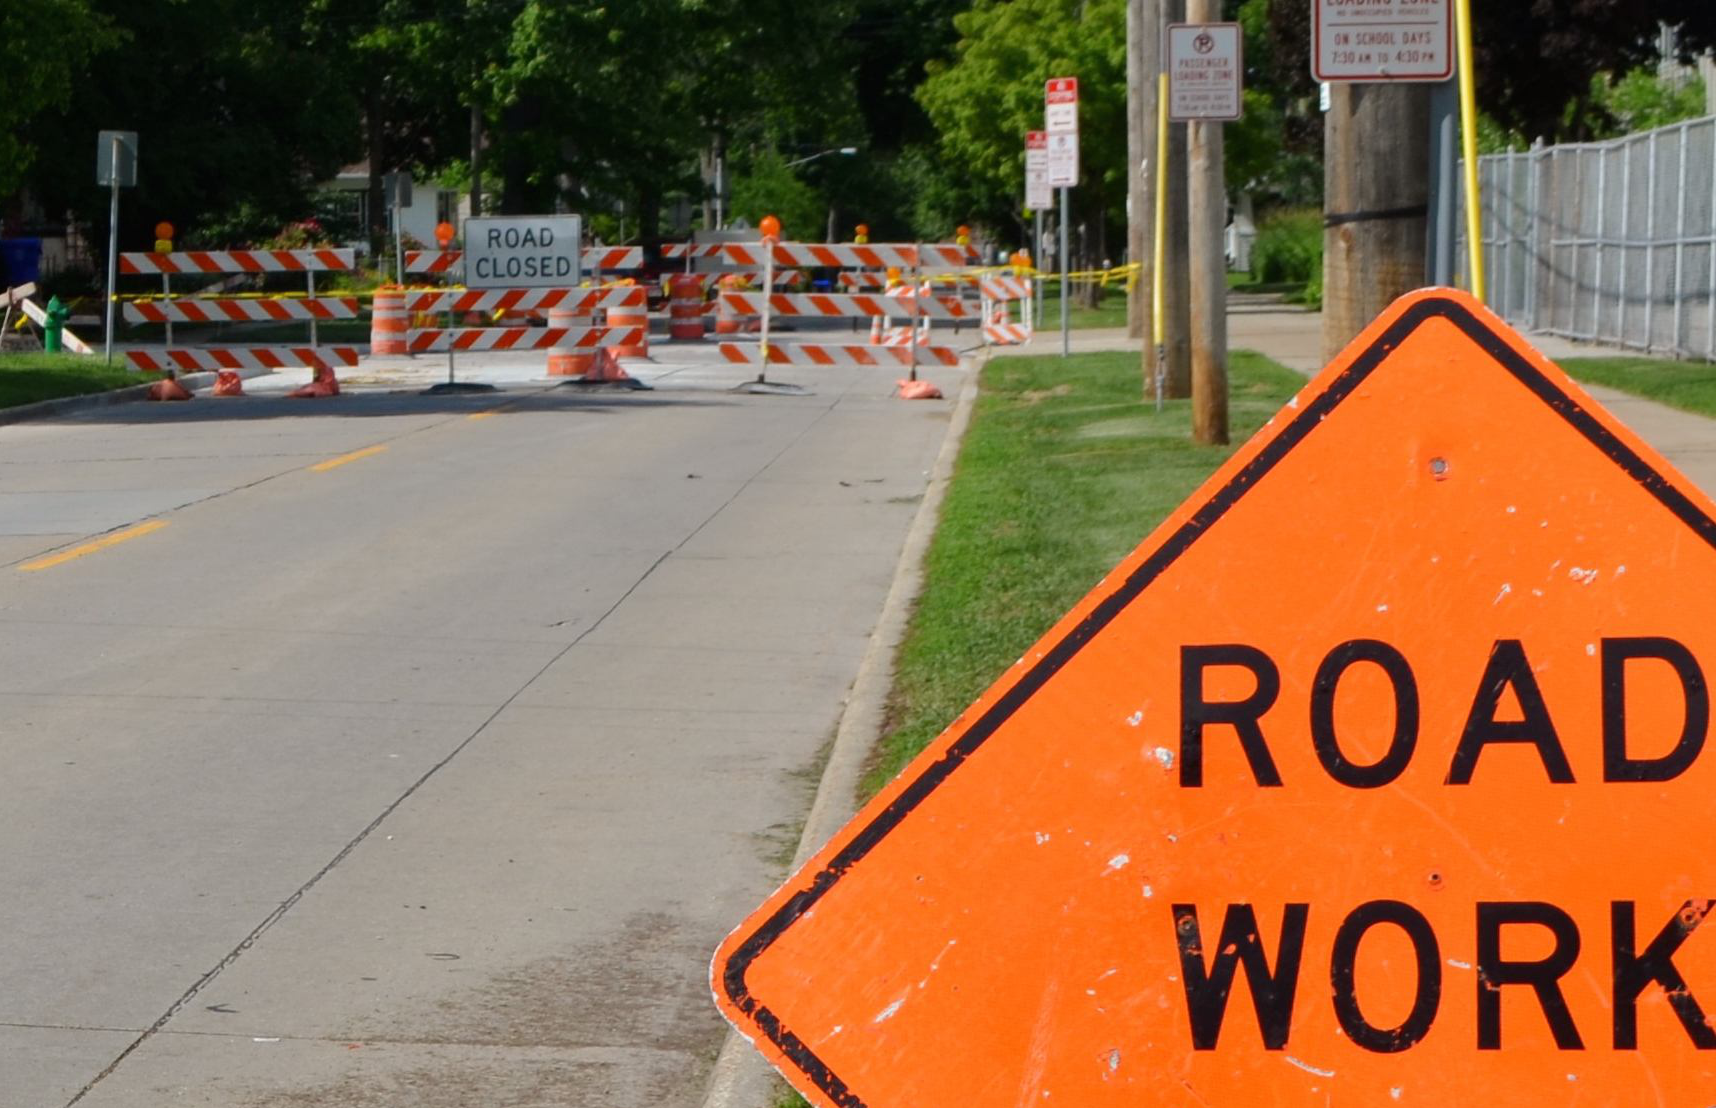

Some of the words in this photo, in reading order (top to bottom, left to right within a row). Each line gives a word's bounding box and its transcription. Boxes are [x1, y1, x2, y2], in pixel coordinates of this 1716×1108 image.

[1334, 32, 1349, 46] ON
[1356, 31, 1396, 46] SCHOOL
[1402, 31, 1432, 45] DAYS
[1332, 51, 1355, 64] 7:30
[1358, 53, 1372, 64] AM
[1378, 52, 1389, 64] TO
[1395, 50, 1420, 64] 4:30
[1422, 52, 1436, 63] PM
[488, 227, 554, 249] ROAD
[475, 256, 571, 279] CLOSED
[1179, 637, 1709, 790] ROAD
[1172, 899, 1716, 1053] WORK
